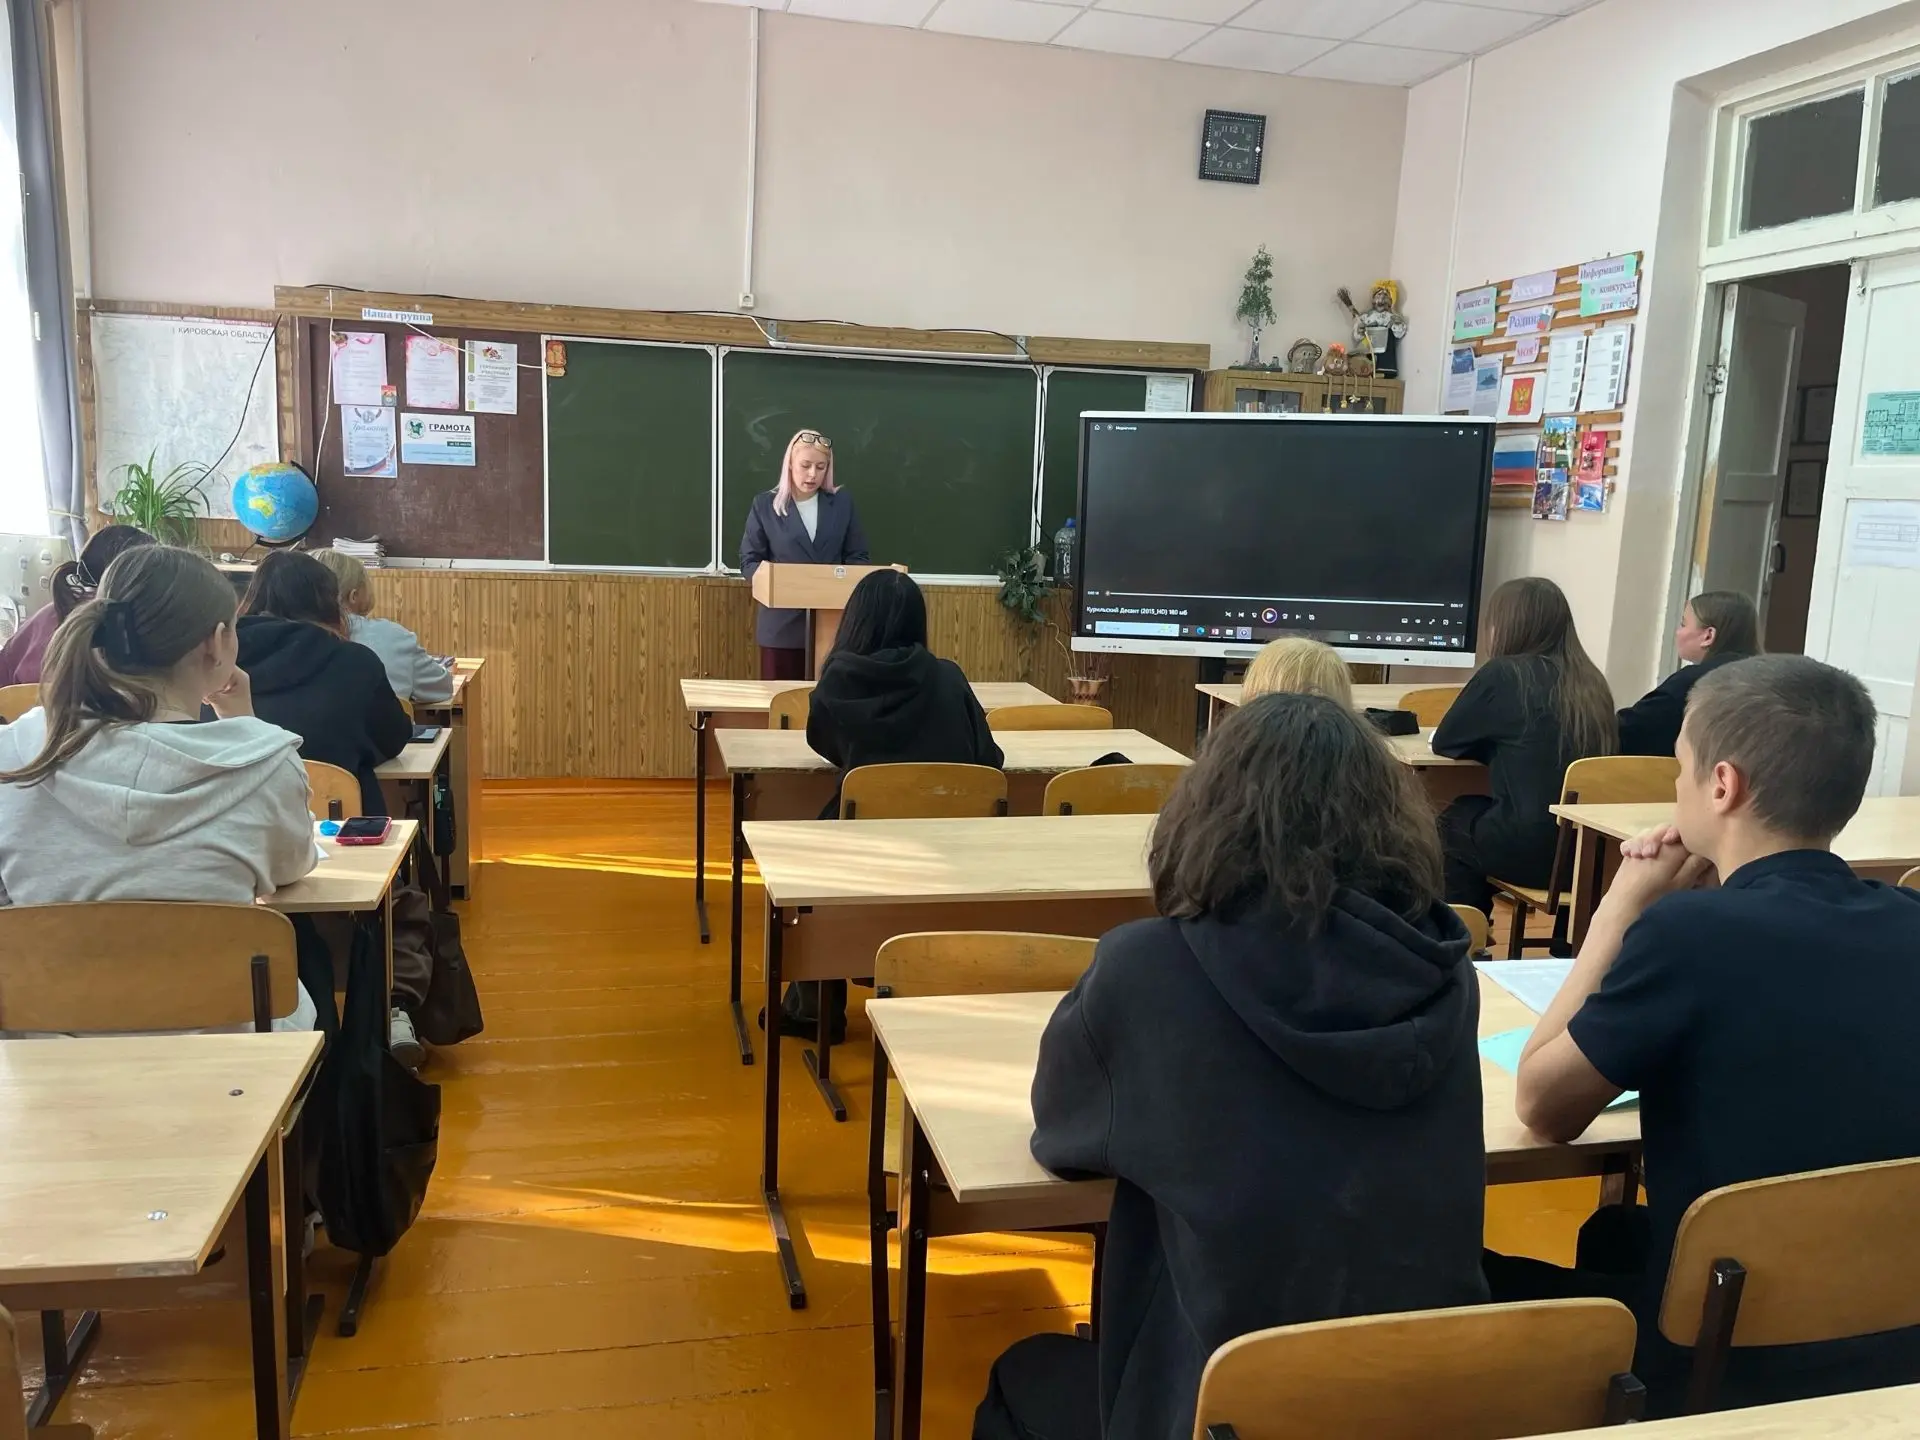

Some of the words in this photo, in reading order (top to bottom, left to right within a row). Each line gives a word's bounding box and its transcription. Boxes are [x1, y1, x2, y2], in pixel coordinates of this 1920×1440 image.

[1580, 265, 1625, 280] Информация
[363, 309, 393, 319] Наша
[395, 312, 432, 323] группа
[178, 327, 229, 338] КИРОВСКАЯ
[230, 330, 269, 340] ОБЛАСТЬ
[428, 423, 471, 432] ГРАМОТА
[1086, 606, 1119, 614] Курильский
[1120, 607, 1140, 615] Десант
